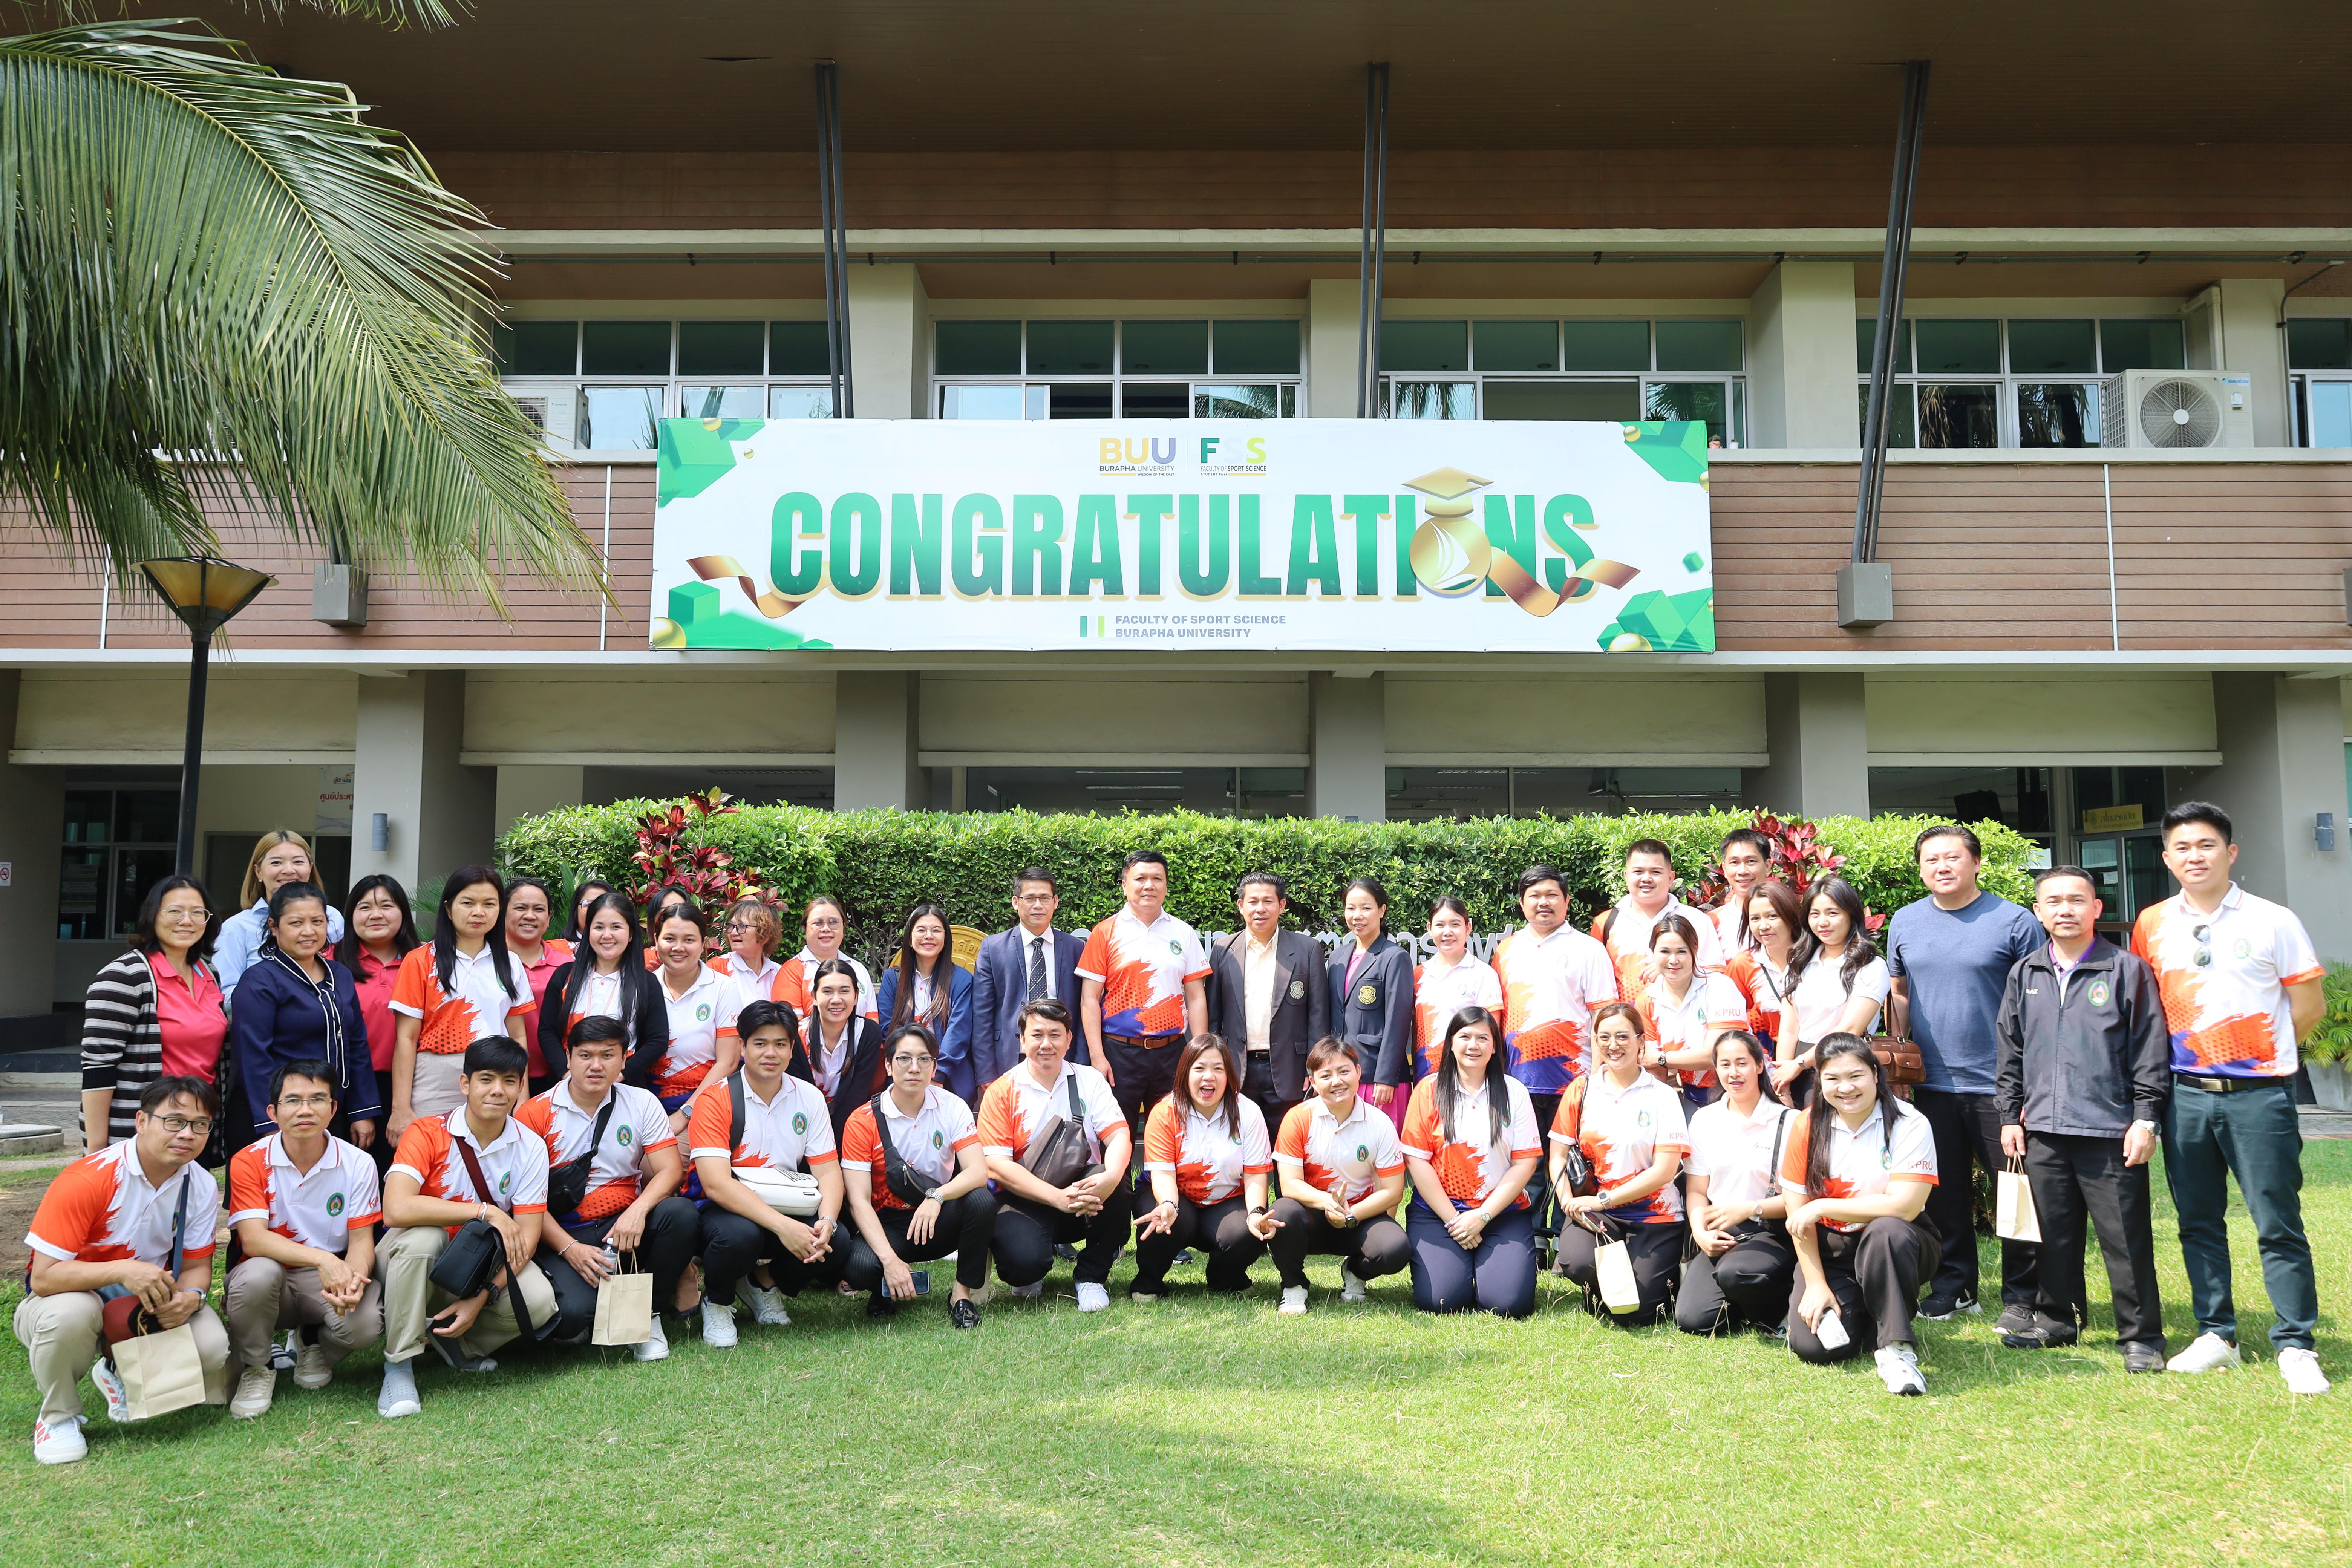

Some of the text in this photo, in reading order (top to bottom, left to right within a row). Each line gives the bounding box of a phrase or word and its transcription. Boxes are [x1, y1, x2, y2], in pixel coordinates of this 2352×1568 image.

[1100, 438, 1176, 464] BUU
[1201, 438, 1266, 464] FSS
[1116, 615, 1286, 624] FACULTY OF SPORT SCIENCE
[1116, 629, 1251, 637] BURAPHA UNIVERSITY
[1715, 1008, 1741, 1017] KPRU
[1669, 1132, 1688, 1141] KPRU
[1908, 1160, 1933, 1170] KPRU
